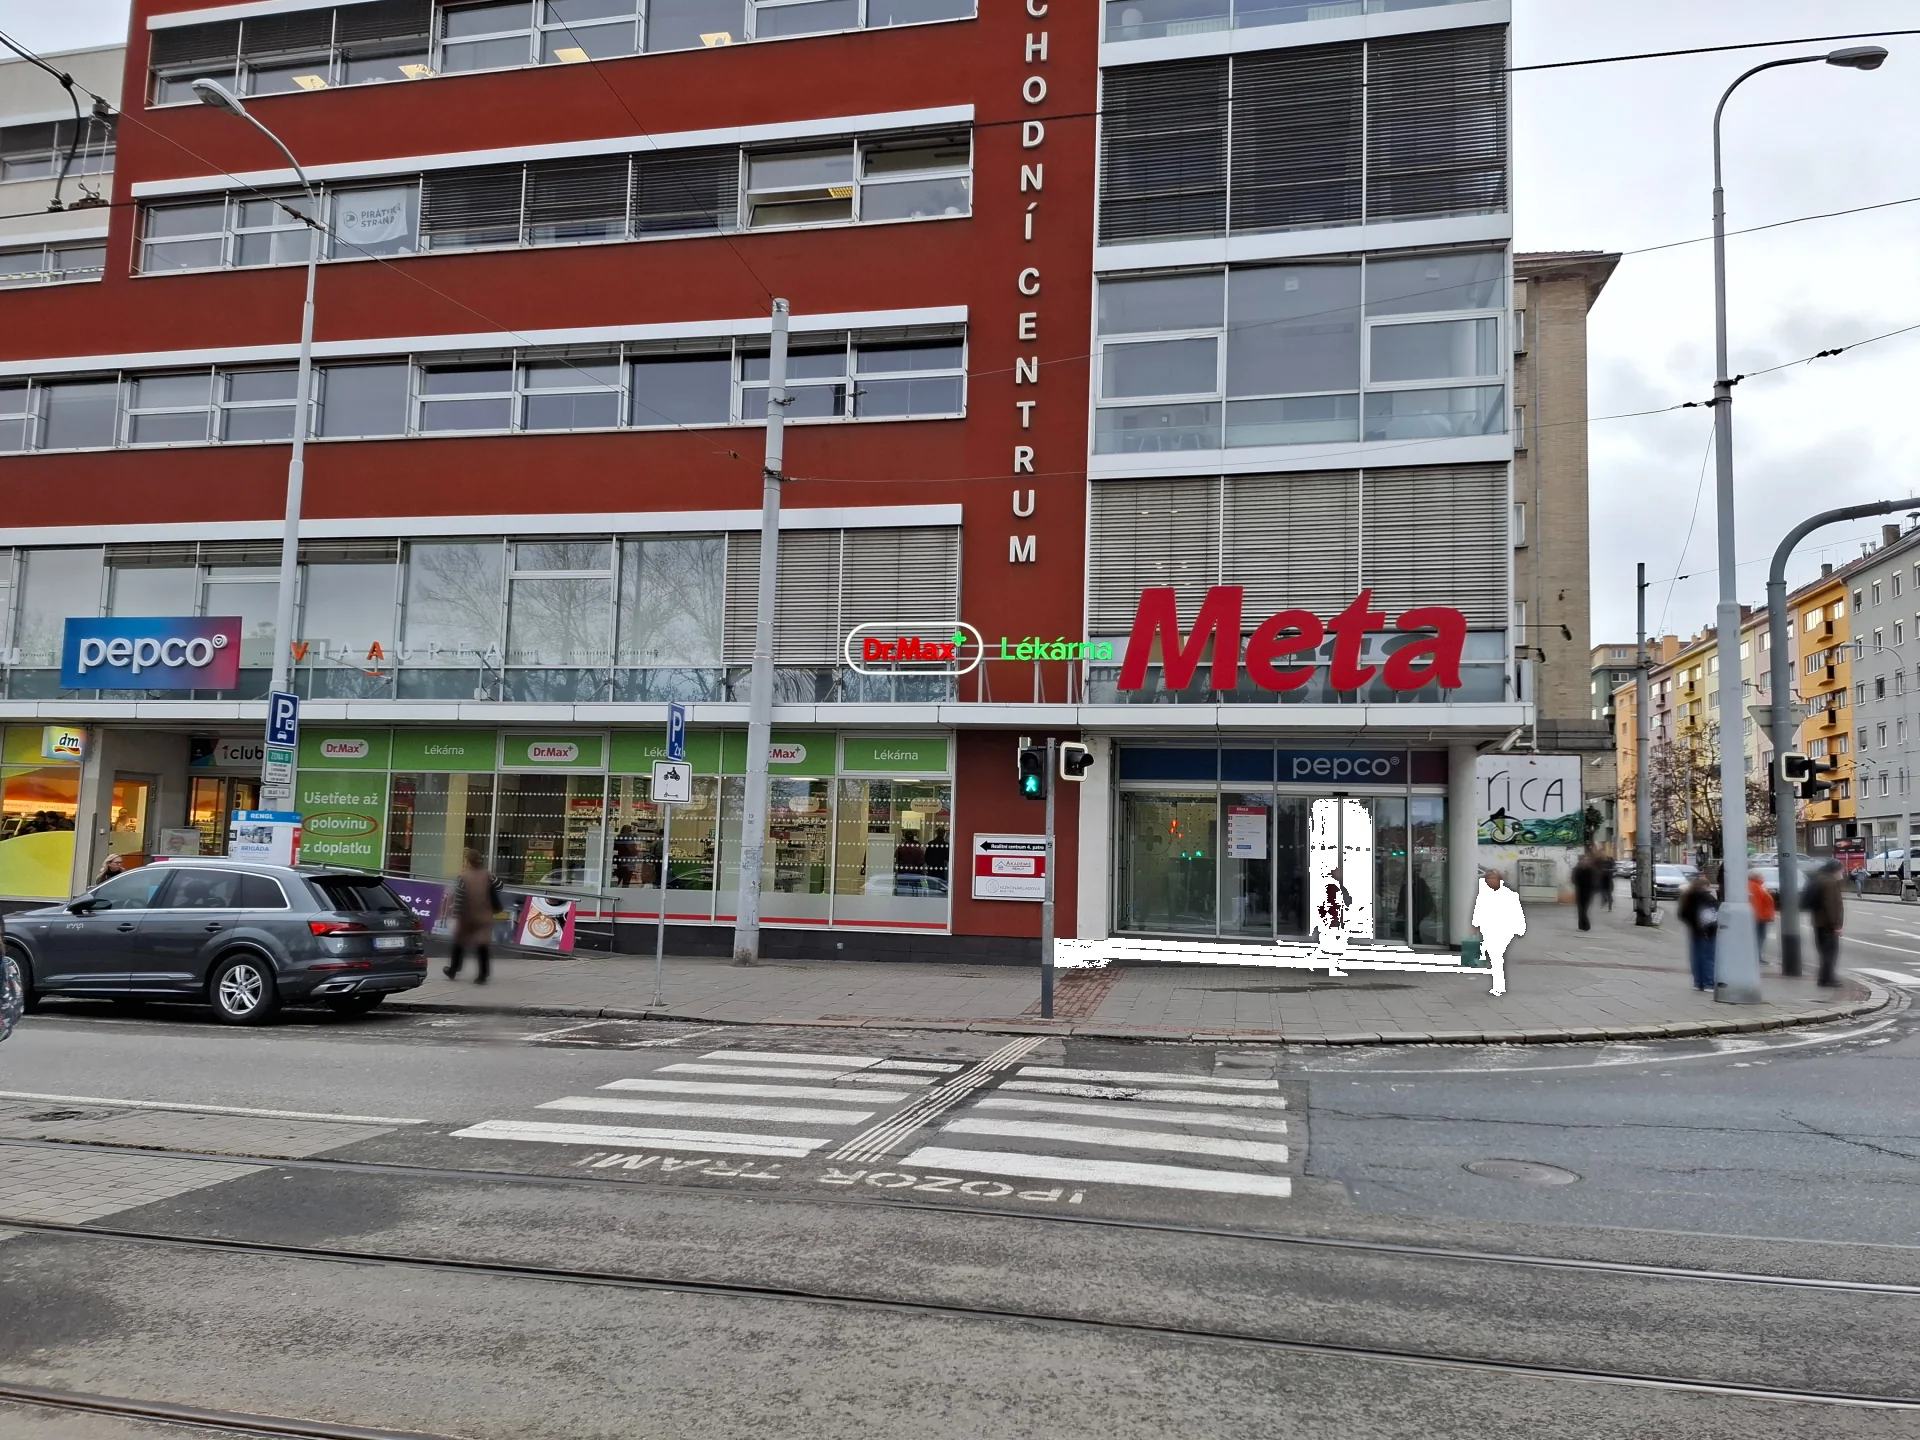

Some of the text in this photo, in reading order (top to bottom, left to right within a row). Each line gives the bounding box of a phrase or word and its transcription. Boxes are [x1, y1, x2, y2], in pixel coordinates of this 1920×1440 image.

[1009, 267, 1040, 563] CENTRUM
[1116, 585, 1467, 691] Meta
[78, 638, 214, 674] pepco
[290, 641, 352, 661] VIA
[1000, 637, 1113, 661] Lékárna
[276, 699, 293, 728] P
[672, 710, 682, 742] P
[59, 733, 79, 747] dm
[424, 744, 465, 755] Lékárna
[874, 749, 919, 760] Lékárna
[1292, 757, 1391, 779] pepco
[303, 791, 378, 805] Ušetřete až
[311, 817, 367, 831] polovinu
[303, 841, 371, 856] z doplatku
